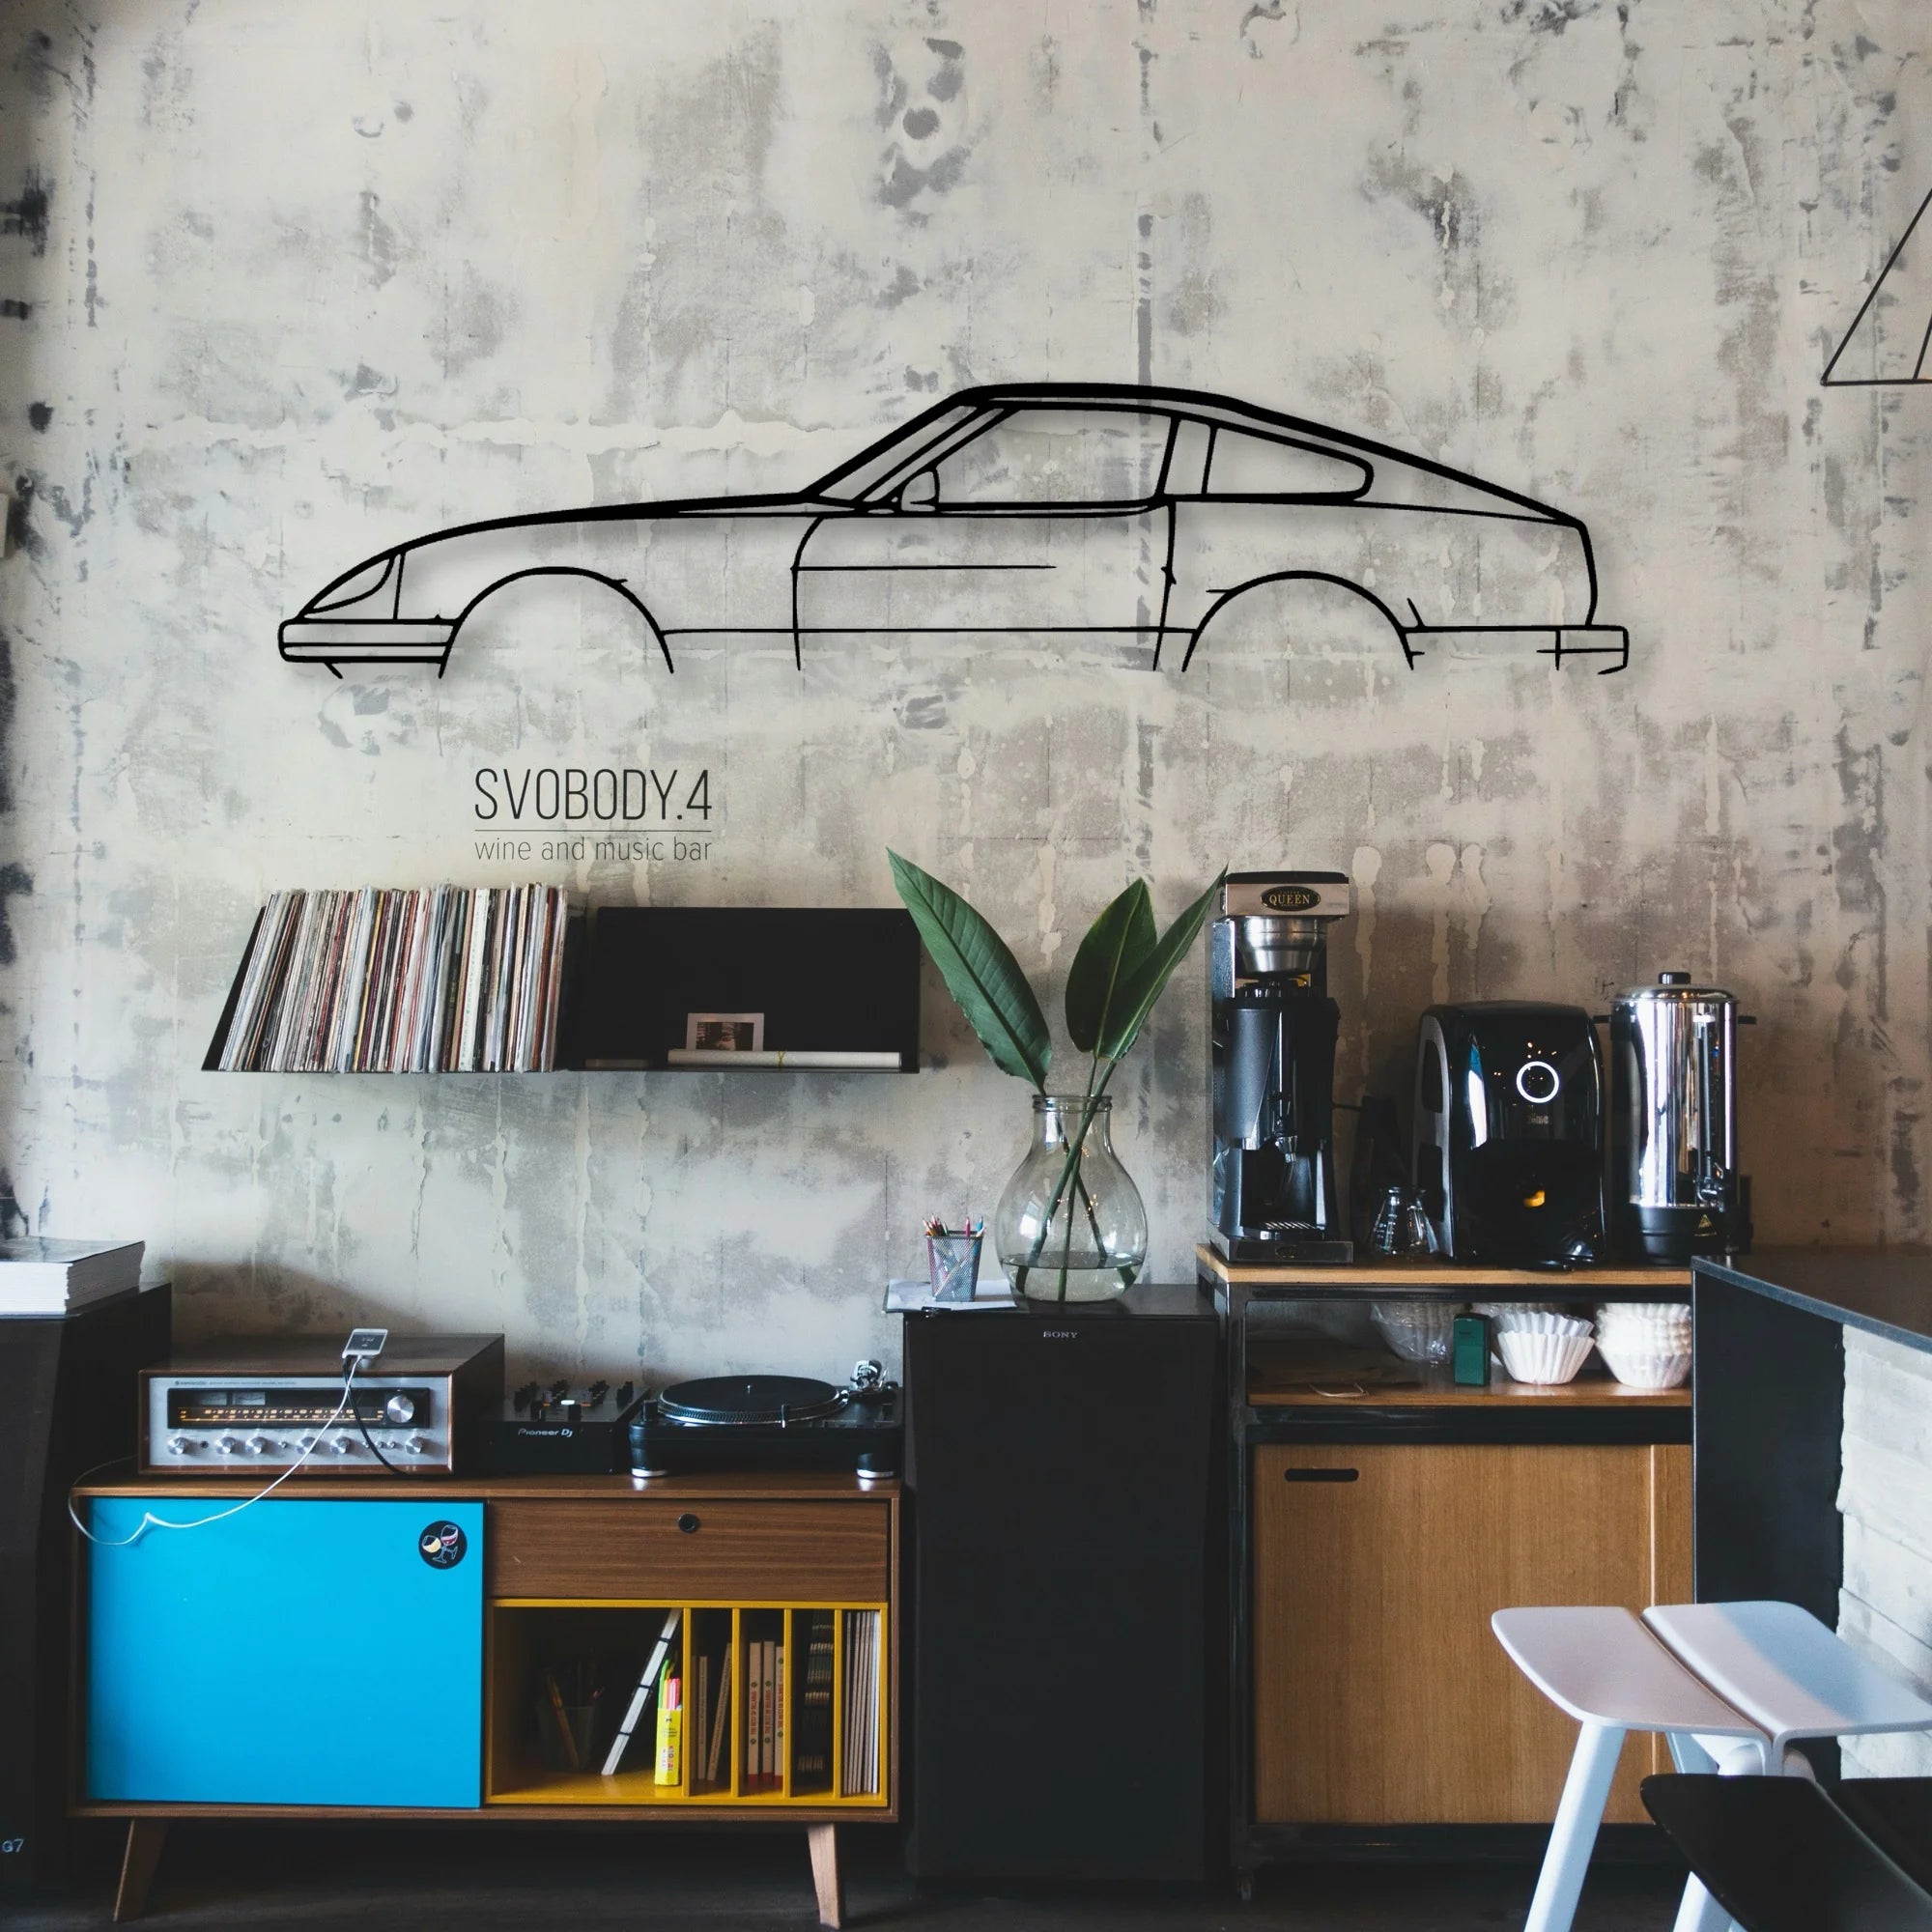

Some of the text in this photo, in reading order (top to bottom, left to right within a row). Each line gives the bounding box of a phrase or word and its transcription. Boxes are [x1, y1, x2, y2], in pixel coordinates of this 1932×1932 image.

[474, 768, 712, 820] SVOBODY.4
[474, 837, 712, 861] wine and music bar
[1269, 895, 1310, 906] QUEEN
[2, 1838, 24, 1853] G7
